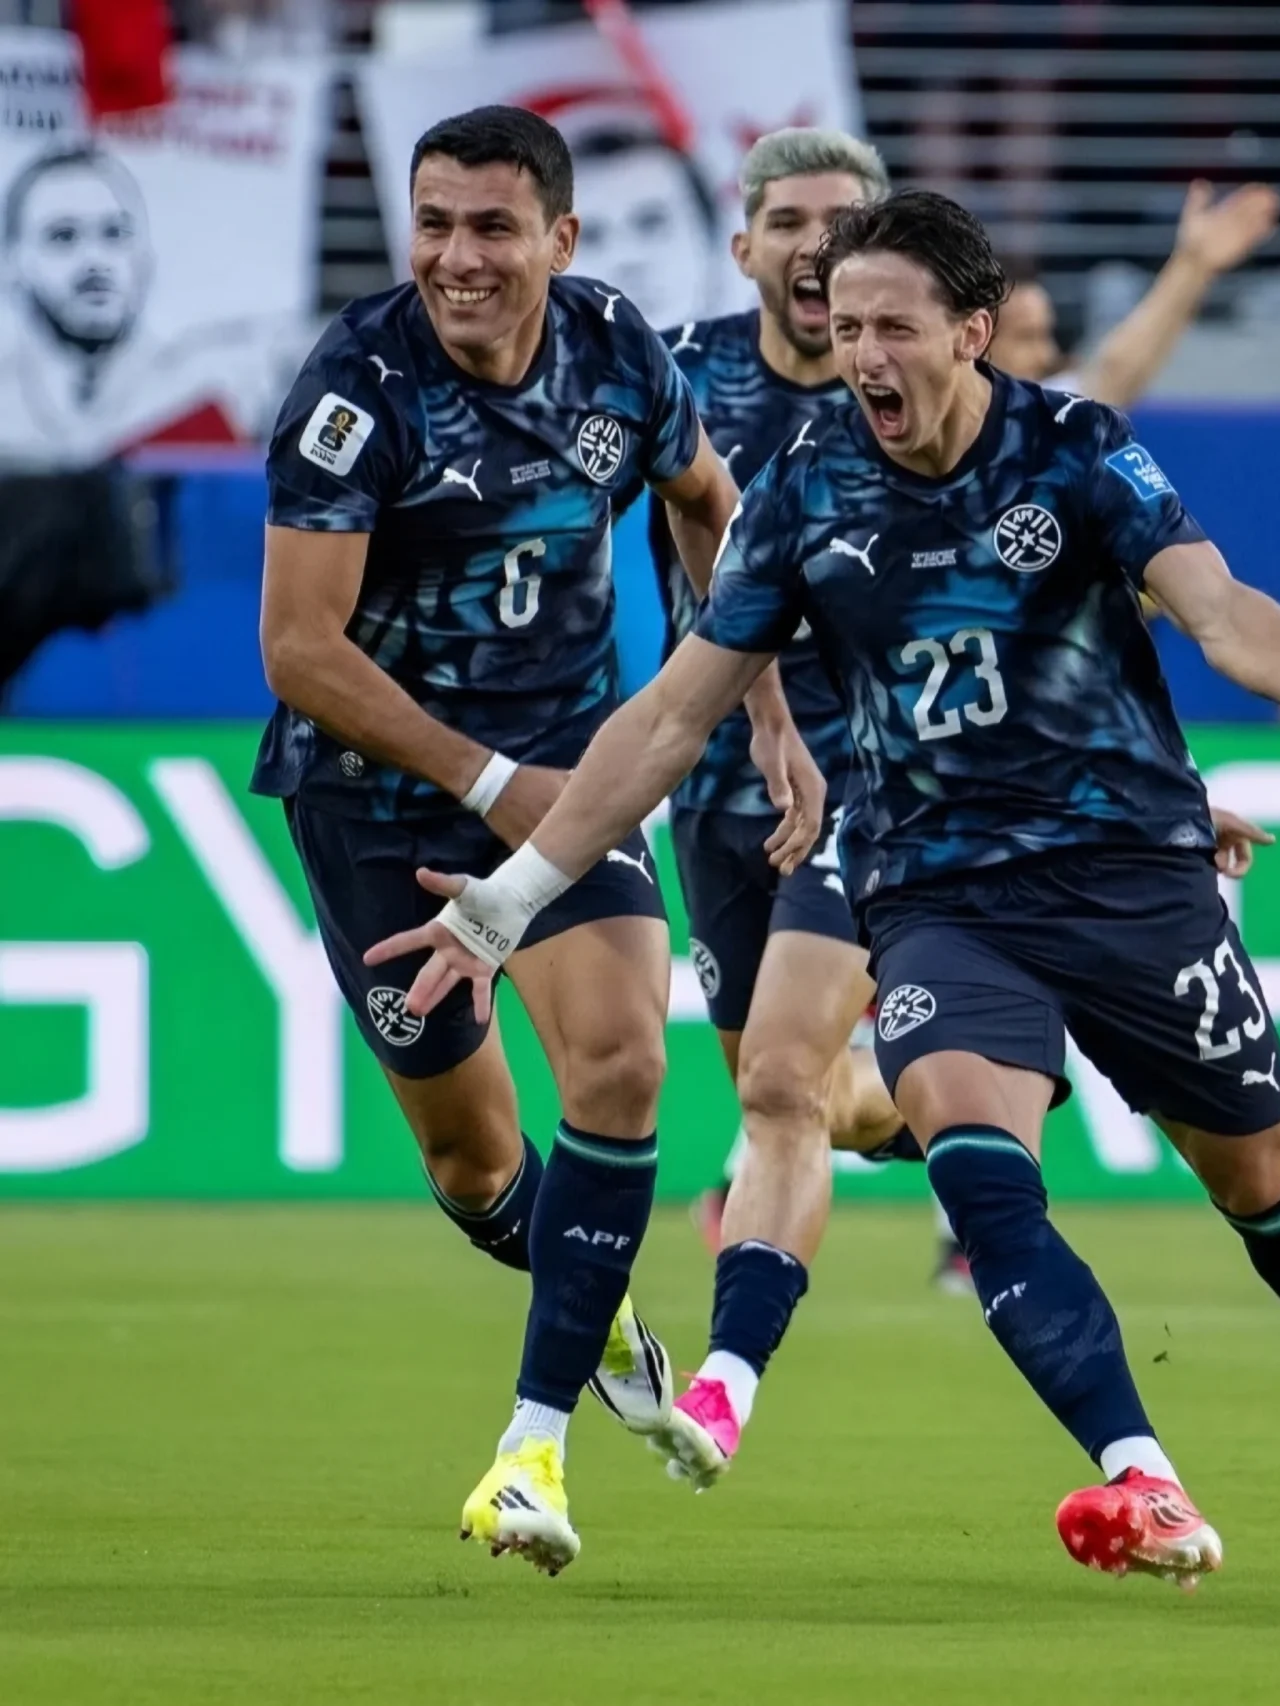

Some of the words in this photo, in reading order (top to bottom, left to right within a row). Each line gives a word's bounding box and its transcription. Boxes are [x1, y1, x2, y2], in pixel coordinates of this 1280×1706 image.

[499, 537, 547, 629] 6
[900, 627, 1008, 741] 23
[1173, 935, 1266, 1061] 23
[562, 1224, 631, 1250] APF
